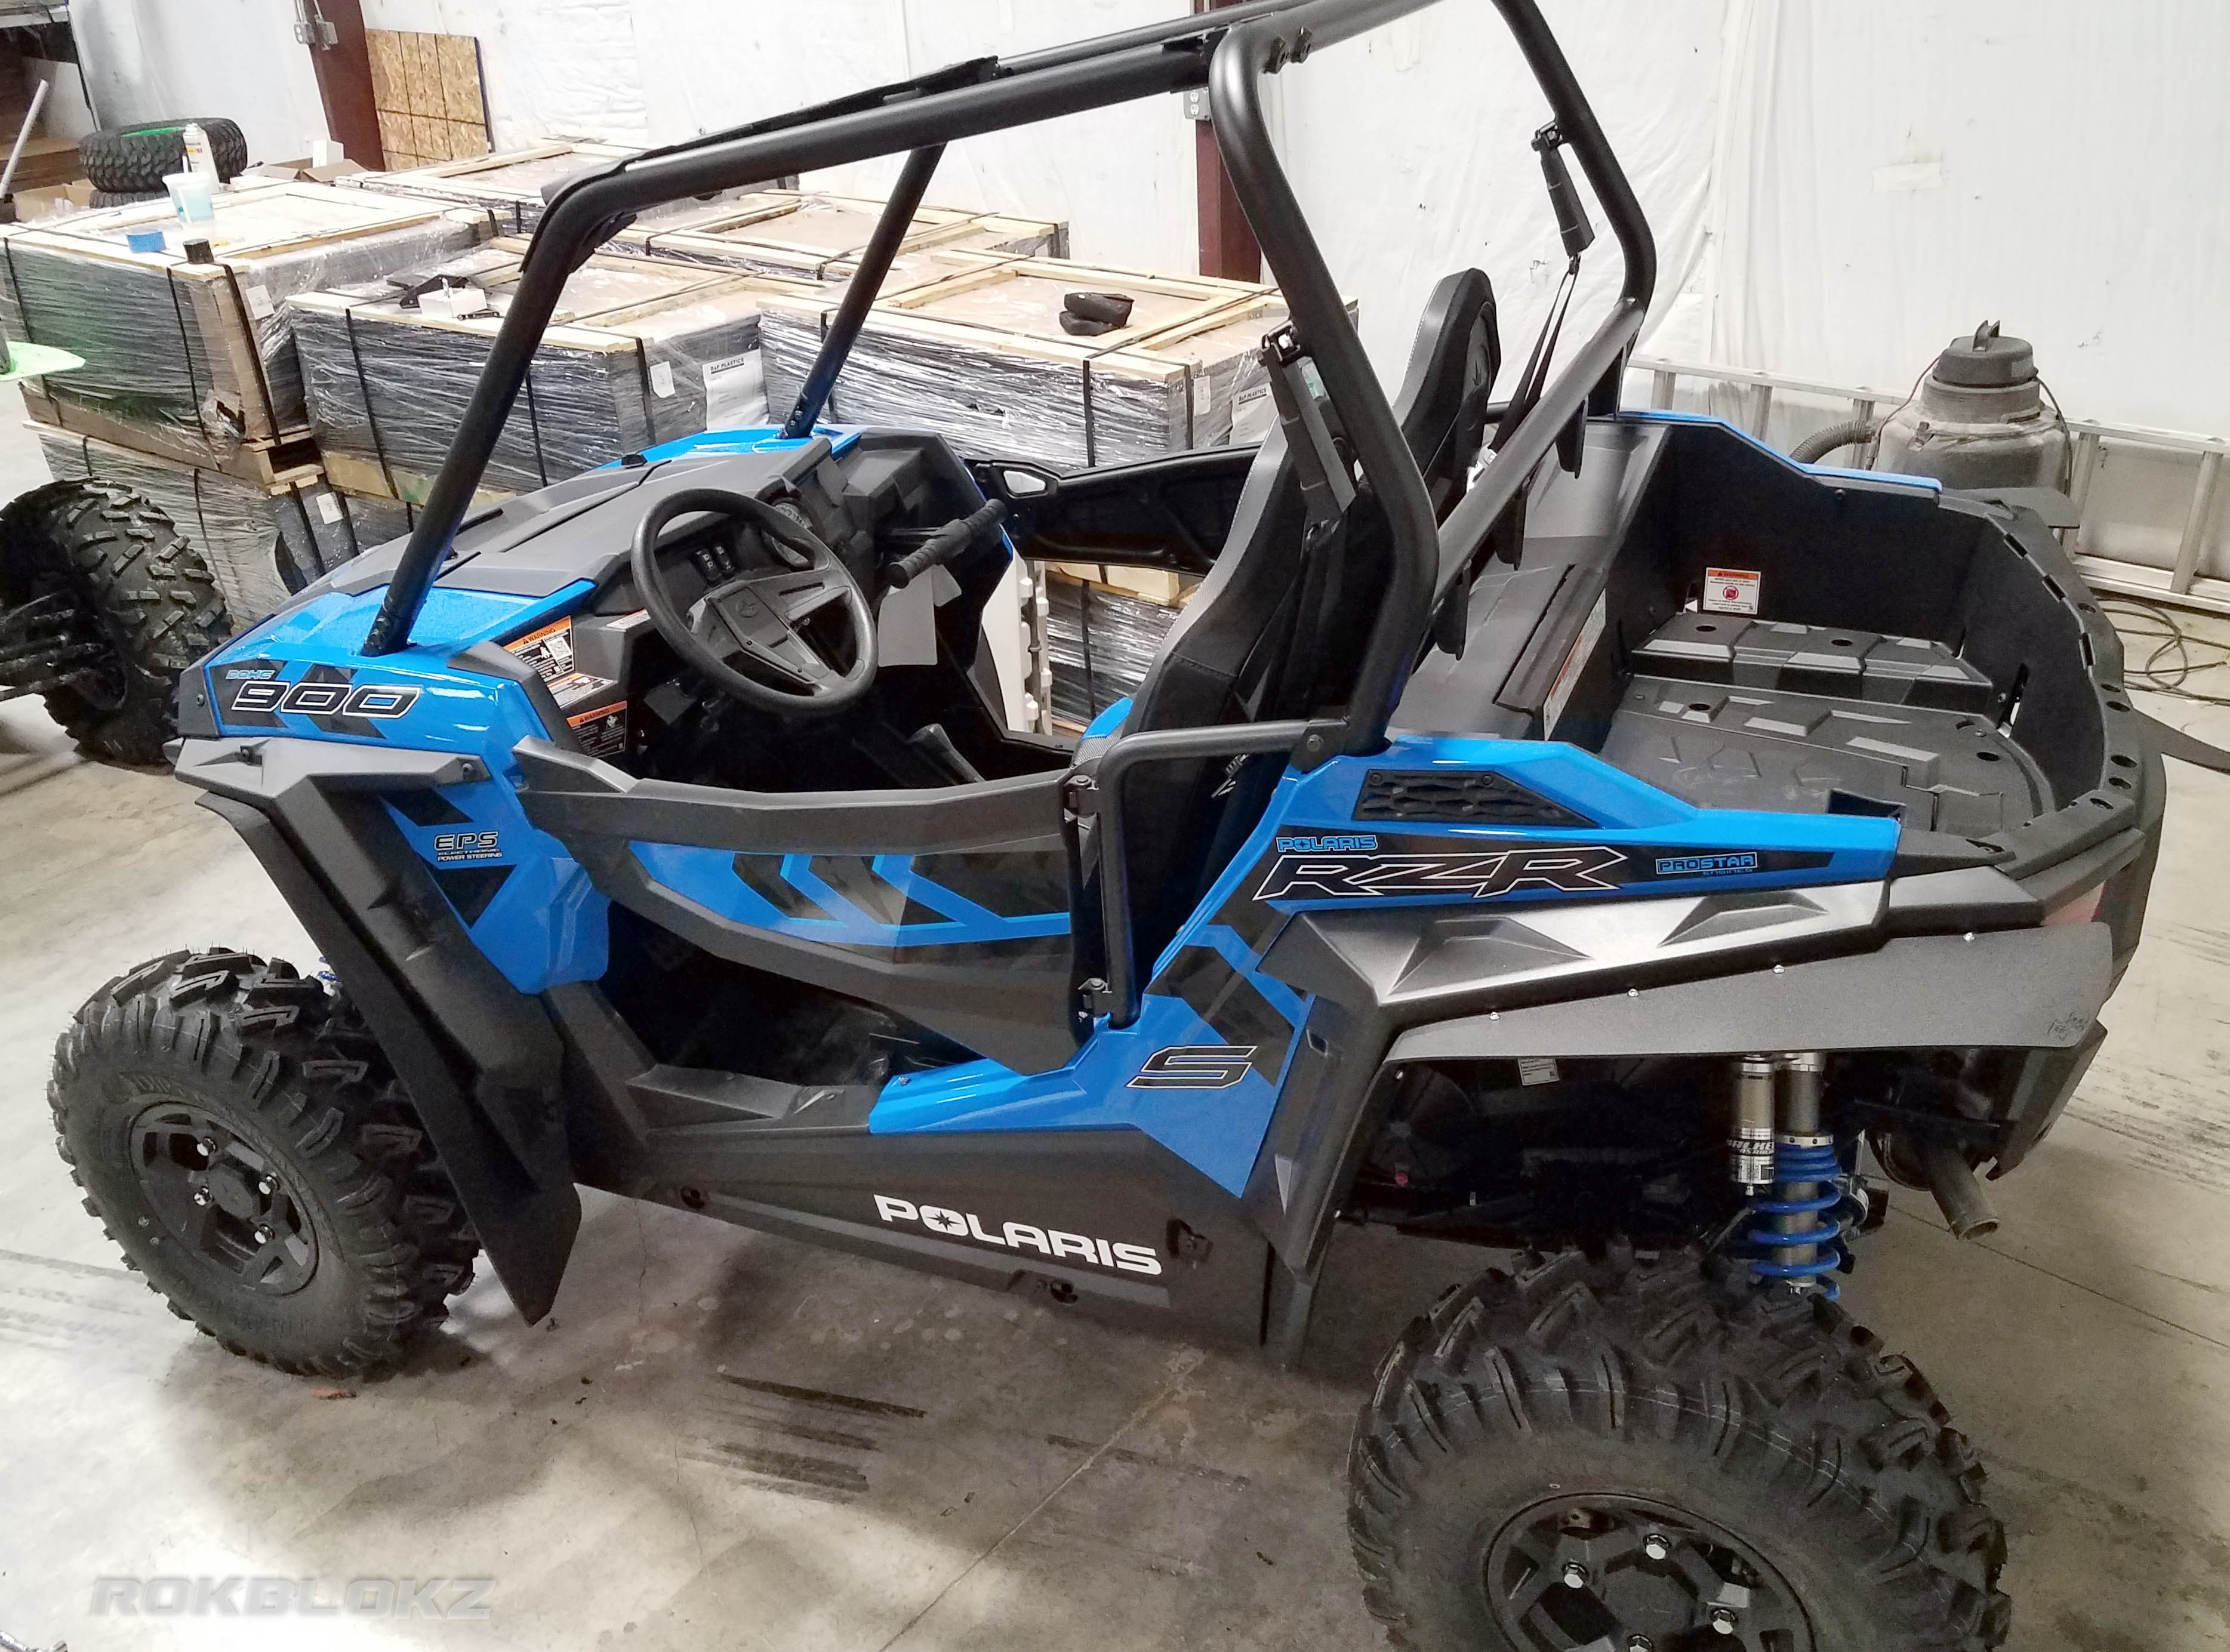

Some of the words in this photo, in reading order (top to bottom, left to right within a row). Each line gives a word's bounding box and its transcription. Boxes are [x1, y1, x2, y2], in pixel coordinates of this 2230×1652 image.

[721, 357, 744, 369] PLASTICS
[528, 627, 556, 643] WARNING
[231, 680, 421, 718] 900
[435, 831, 499, 850] EPS
[1276, 835, 1378, 852] POLARIS
[1253, 846, 1628, 900] RZR
[1658, 854, 1755, 873] PROSTAR
[873, 1194, 1162, 1275] POLARIS
